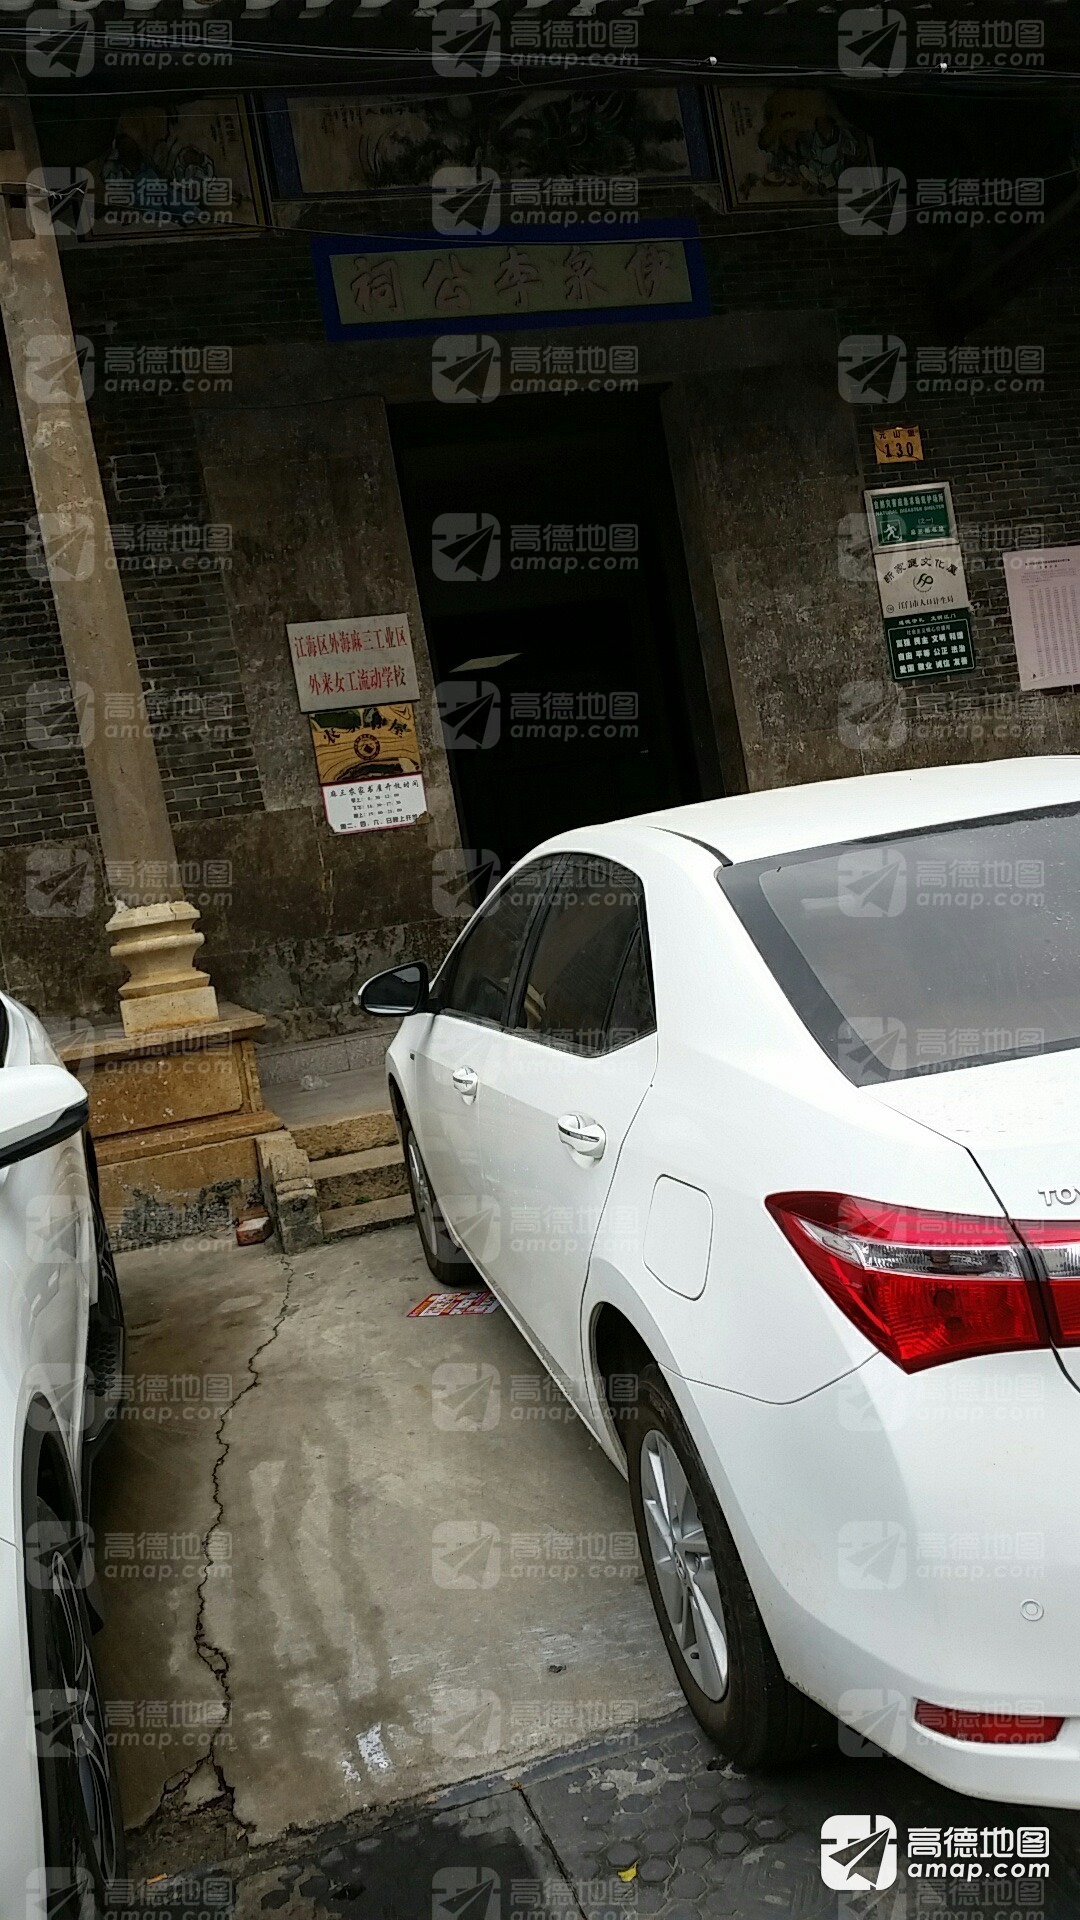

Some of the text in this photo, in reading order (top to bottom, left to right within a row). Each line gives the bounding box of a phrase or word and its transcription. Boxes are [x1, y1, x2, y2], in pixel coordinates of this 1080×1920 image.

[885, 442, 913, 457] 130
[294, 626, 407, 659] 江海区外海麻三工业区
[896, 630, 964, 649] 富强 民主 文明 和谐
[897, 644, 966, 662] 自由 平等 公正 法治
[899, 656, 968, 675] 爱国 敬业 诚信 友善
[309, 665, 406, 696] 外来女工流动学校
